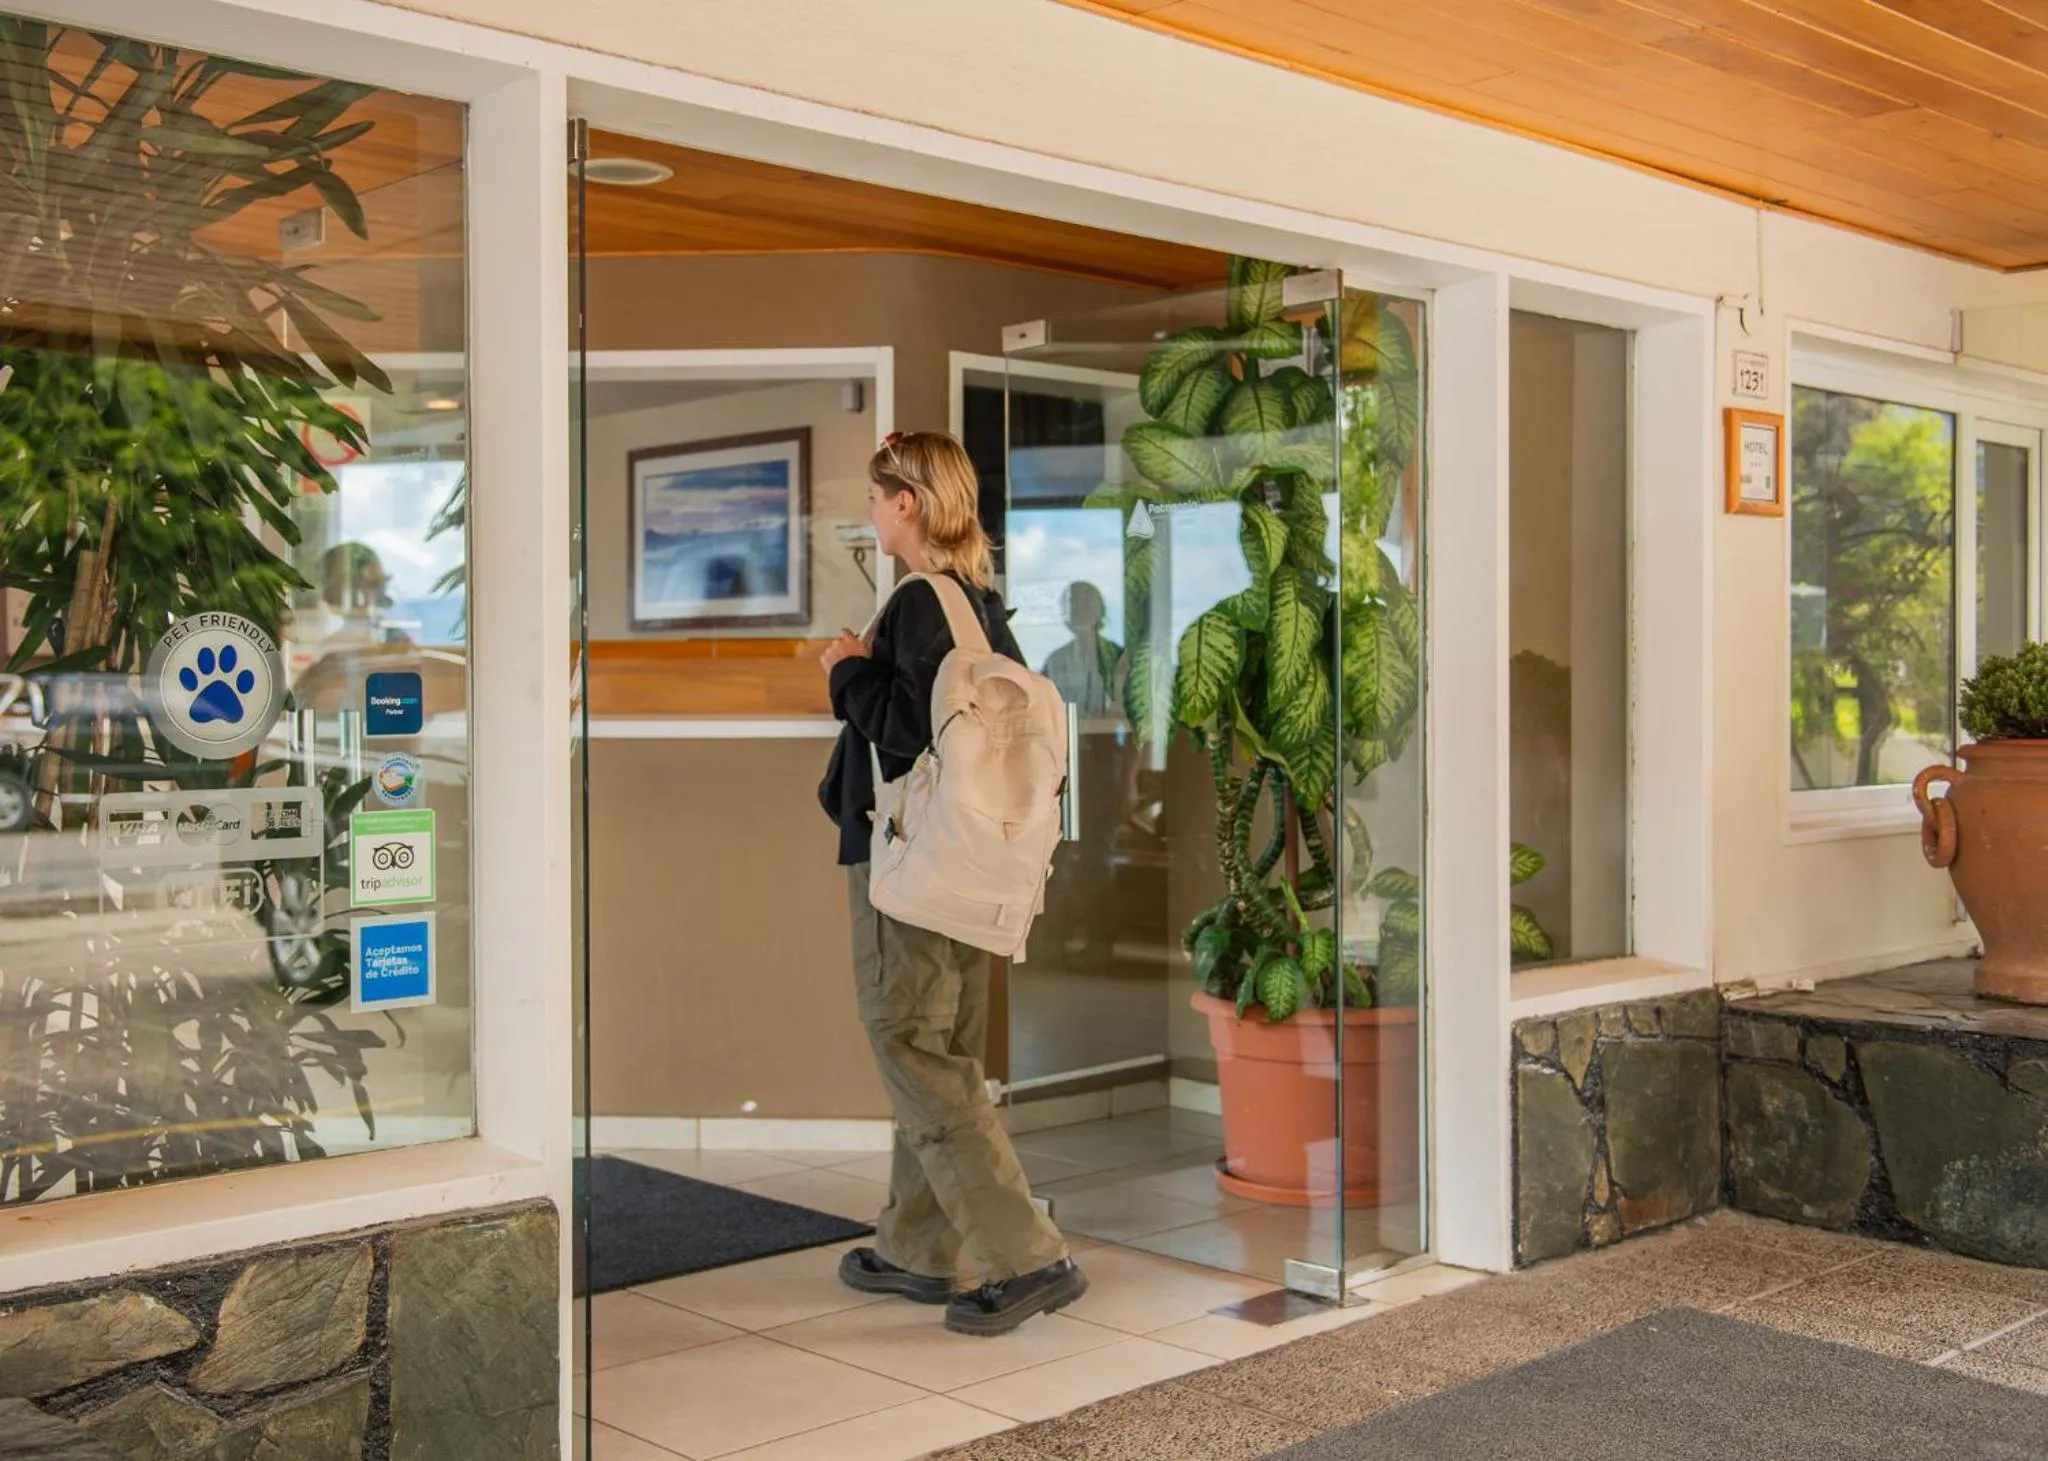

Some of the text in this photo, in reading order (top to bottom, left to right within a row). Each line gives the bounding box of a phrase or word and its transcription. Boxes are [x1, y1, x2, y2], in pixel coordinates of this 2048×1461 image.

[1744, 440, 1768, 455] HOTEL
[163, 614, 275, 654] PET FRIENDLY
[370, 696, 419, 706] Booking.com
[178, 820, 241, 832] MasteCard
[360, 876, 424, 892] tripadvisor
[365, 944, 423, 957] Aceptamos
[365, 956, 408, 969] Tarjetas
[365, 965, 420, 979] de Crédito
